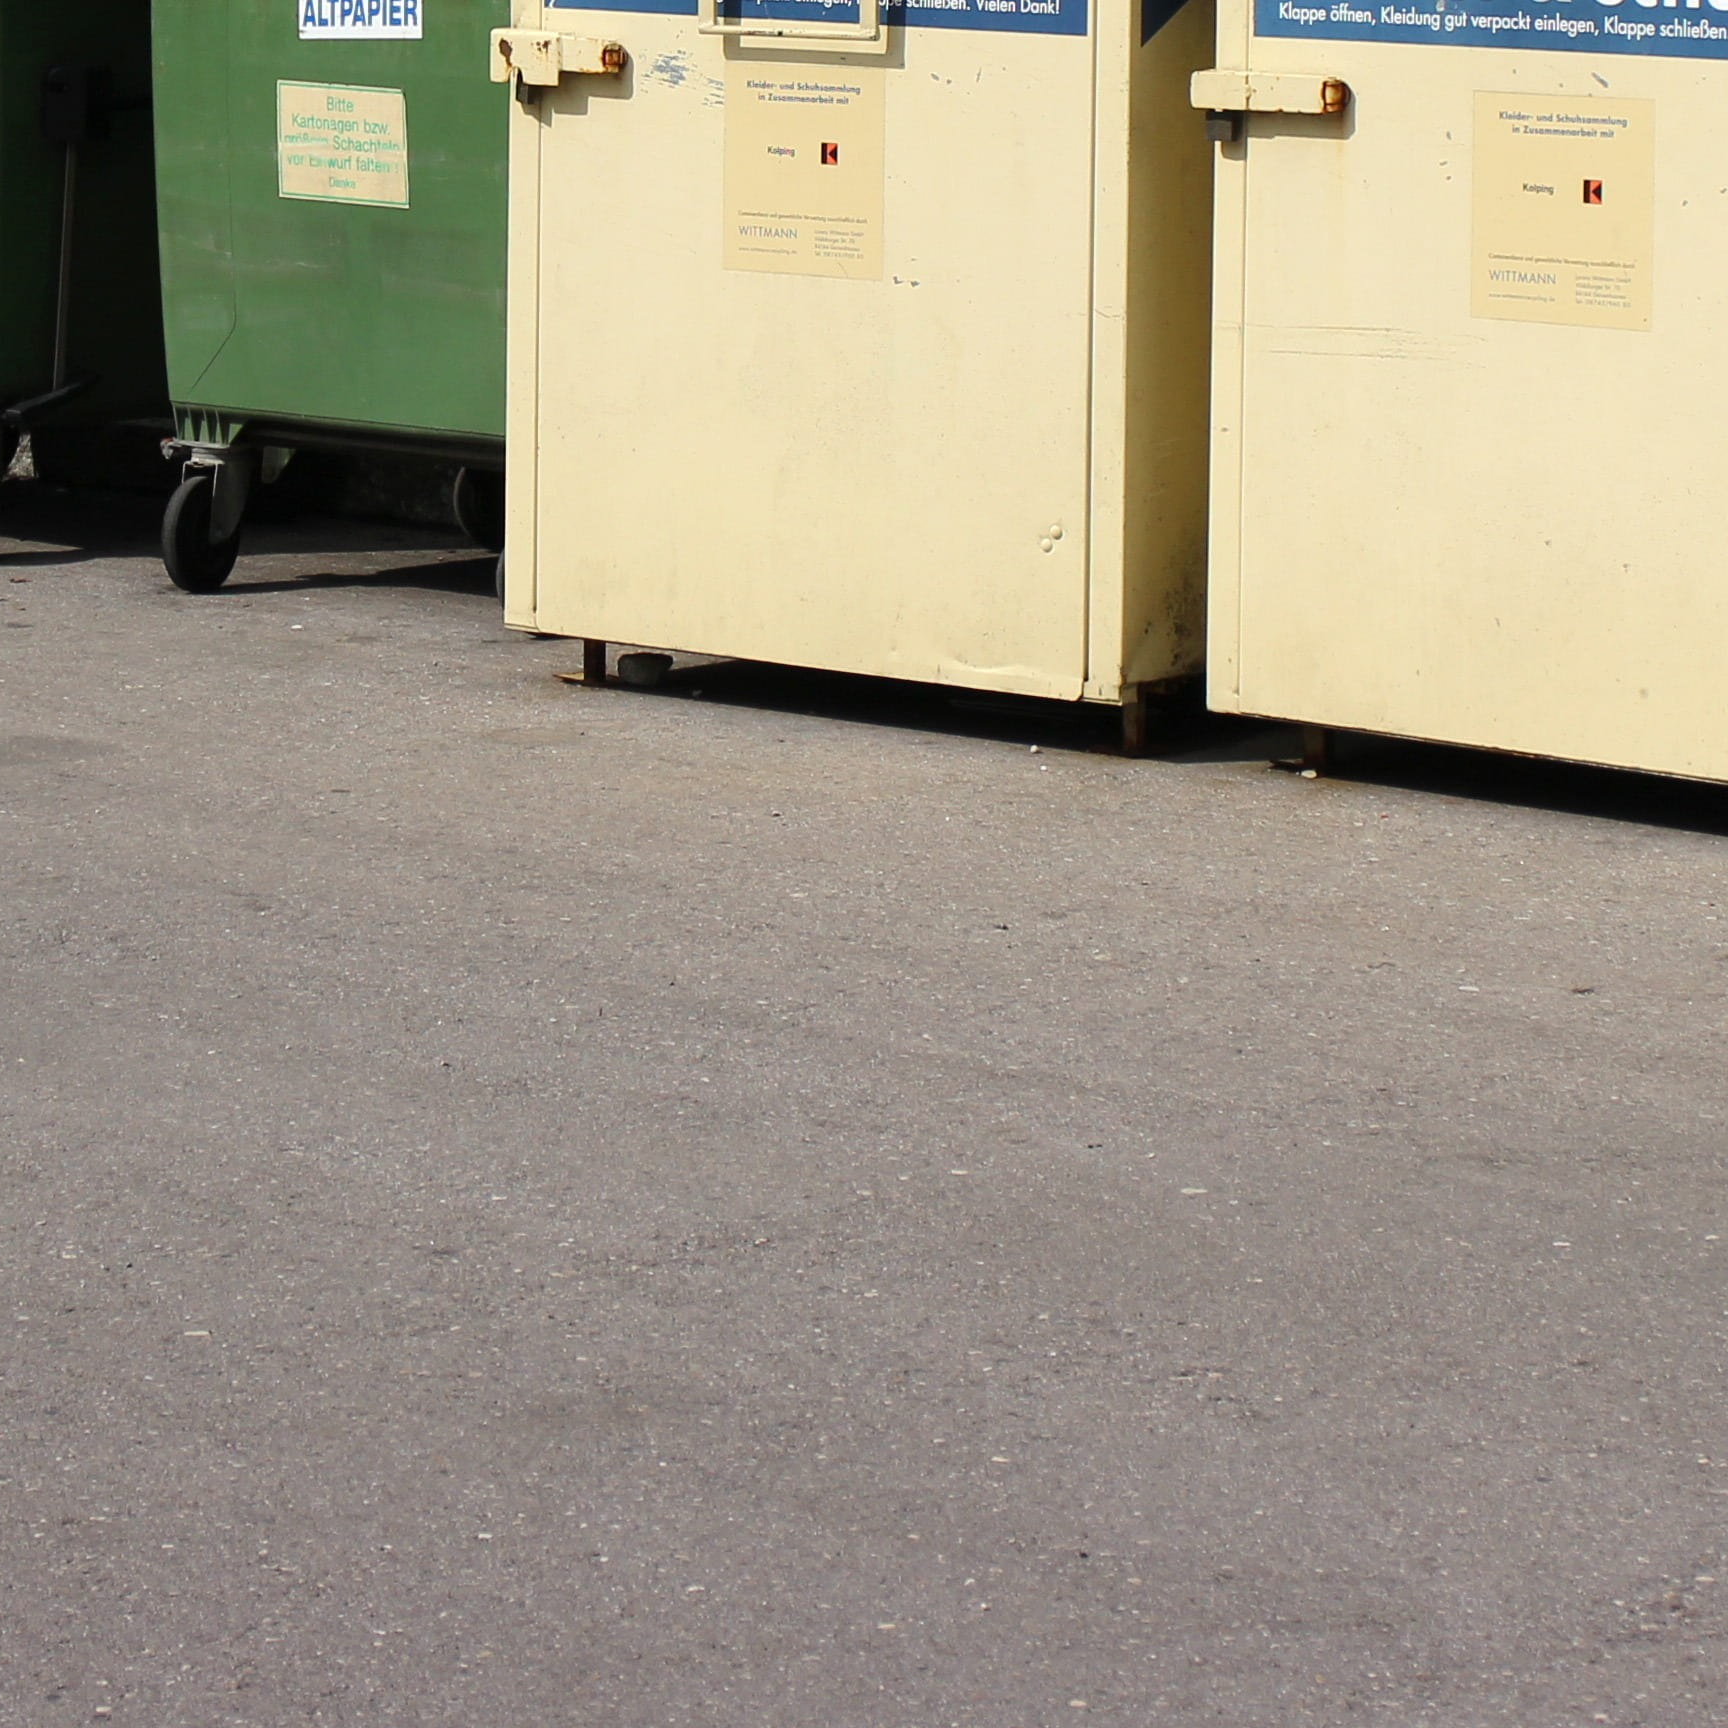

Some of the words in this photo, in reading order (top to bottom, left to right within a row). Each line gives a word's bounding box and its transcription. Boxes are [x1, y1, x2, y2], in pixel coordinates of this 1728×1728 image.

[1279, 1, 1326, 25] Klappe
[1330, 3, 1376, 26] öffnen,
[1381, 6, 1440, 31] Kleidung
[1444, 11, 1467, 31] gut
[1471, 12, 1531, 33] verpackt
[1534, 13, 1599, 37] einlegen,
[1604, 16, 1655, 41] Klappe
[746, 80, 777, 89] Kleider-
[779, 81, 795, 90] und
[797, 83, 861, 95] Schuhsammlung
[326, 96, 354, 112] Bitte
[758, 92, 766, 100] in
[768, 93, 834, 104] Zusammenarbeit
[836, 96, 849, 104] mit
[291, 113, 359, 133] Kartonagen
[363, 119, 391, 135] bzw.
[1499, 111, 1534, 121] Kleider-
[1536, 113, 1553, 122] und
[1556, 114, 1628, 128] Schuhsammlung
[1512, 124, 1520, 133] in
[1523, 125, 1597, 138] Zusammenarbeit
[1600, 129, 1614, 138] mit
[767, 146, 796, 157] Kolping
[1522, 183, 1554, 195] Kolping
[738, 225, 798, 239] WITTMANN
[1488, 269, 1557, 285] WITTMANN
